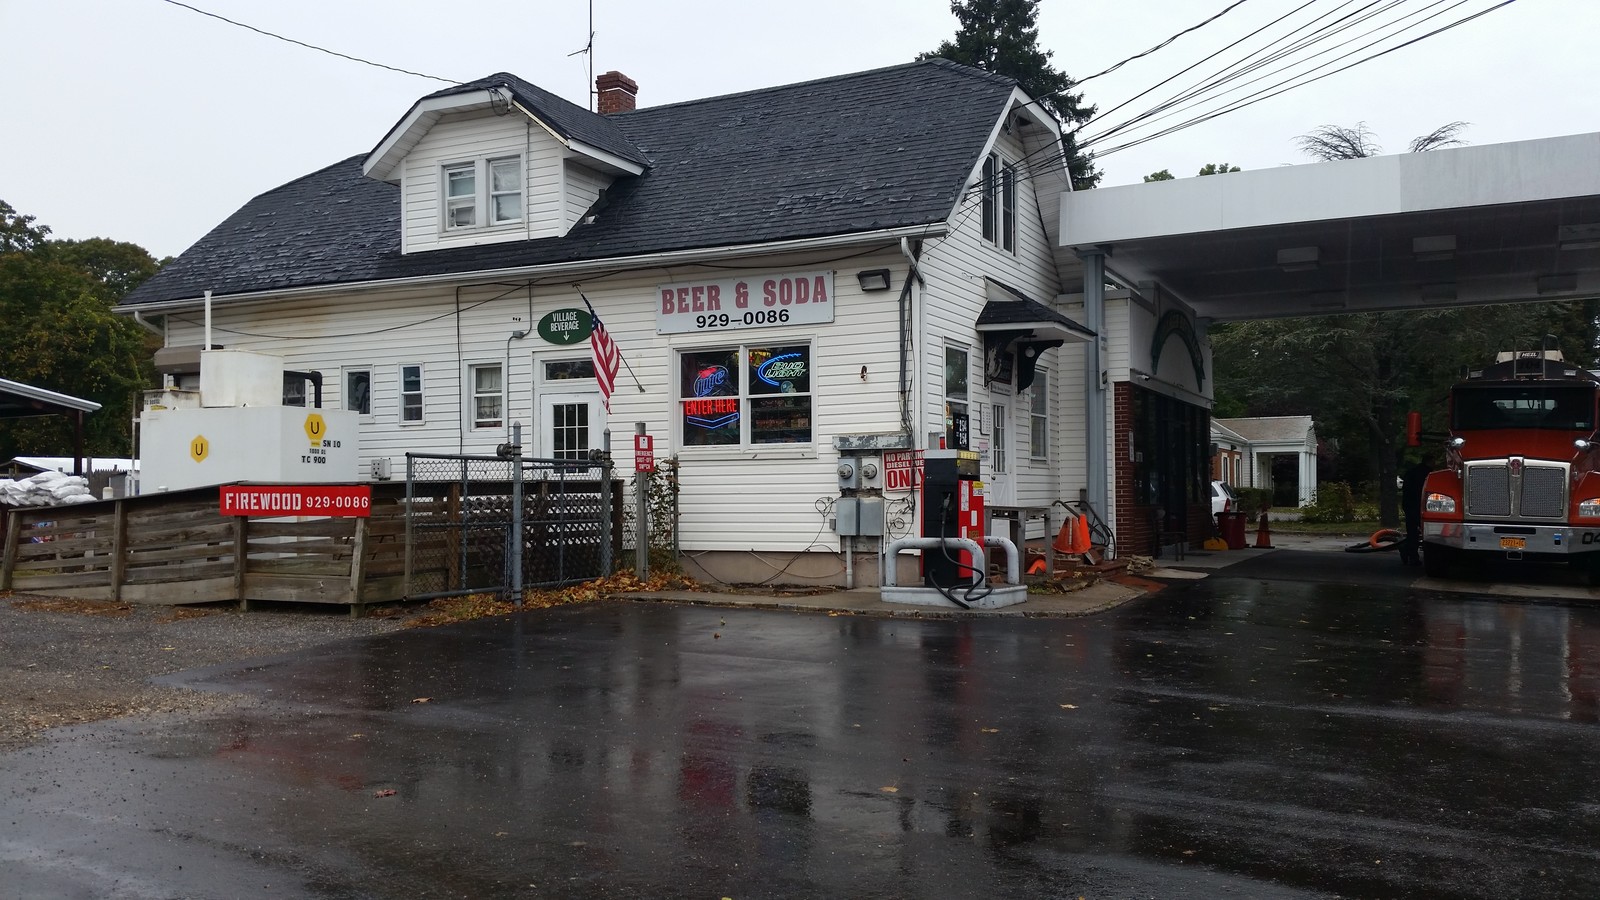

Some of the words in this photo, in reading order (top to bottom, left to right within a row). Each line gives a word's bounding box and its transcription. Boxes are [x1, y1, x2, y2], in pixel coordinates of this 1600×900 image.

[661, 284, 721, 315] BEER
[735, 281, 749, 308] &
[763, 275, 828, 307] SODA
[552, 311, 577, 322] VILLAGE
[696, 308, 790, 329] 929-0086
[550, 320, 579, 332] BEVERAGE
[685, 400, 713, 415] ENTER
[715, 399, 738, 413] HERE
[322, 439, 331, 448] SN
[301, 455, 311, 463] TC
[313, 456, 326, 464] 900
[885, 453, 896, 462] NO
[886, 460, 911, 468] DIESEL
[225, 492, 301, 511] FIREWOOD
